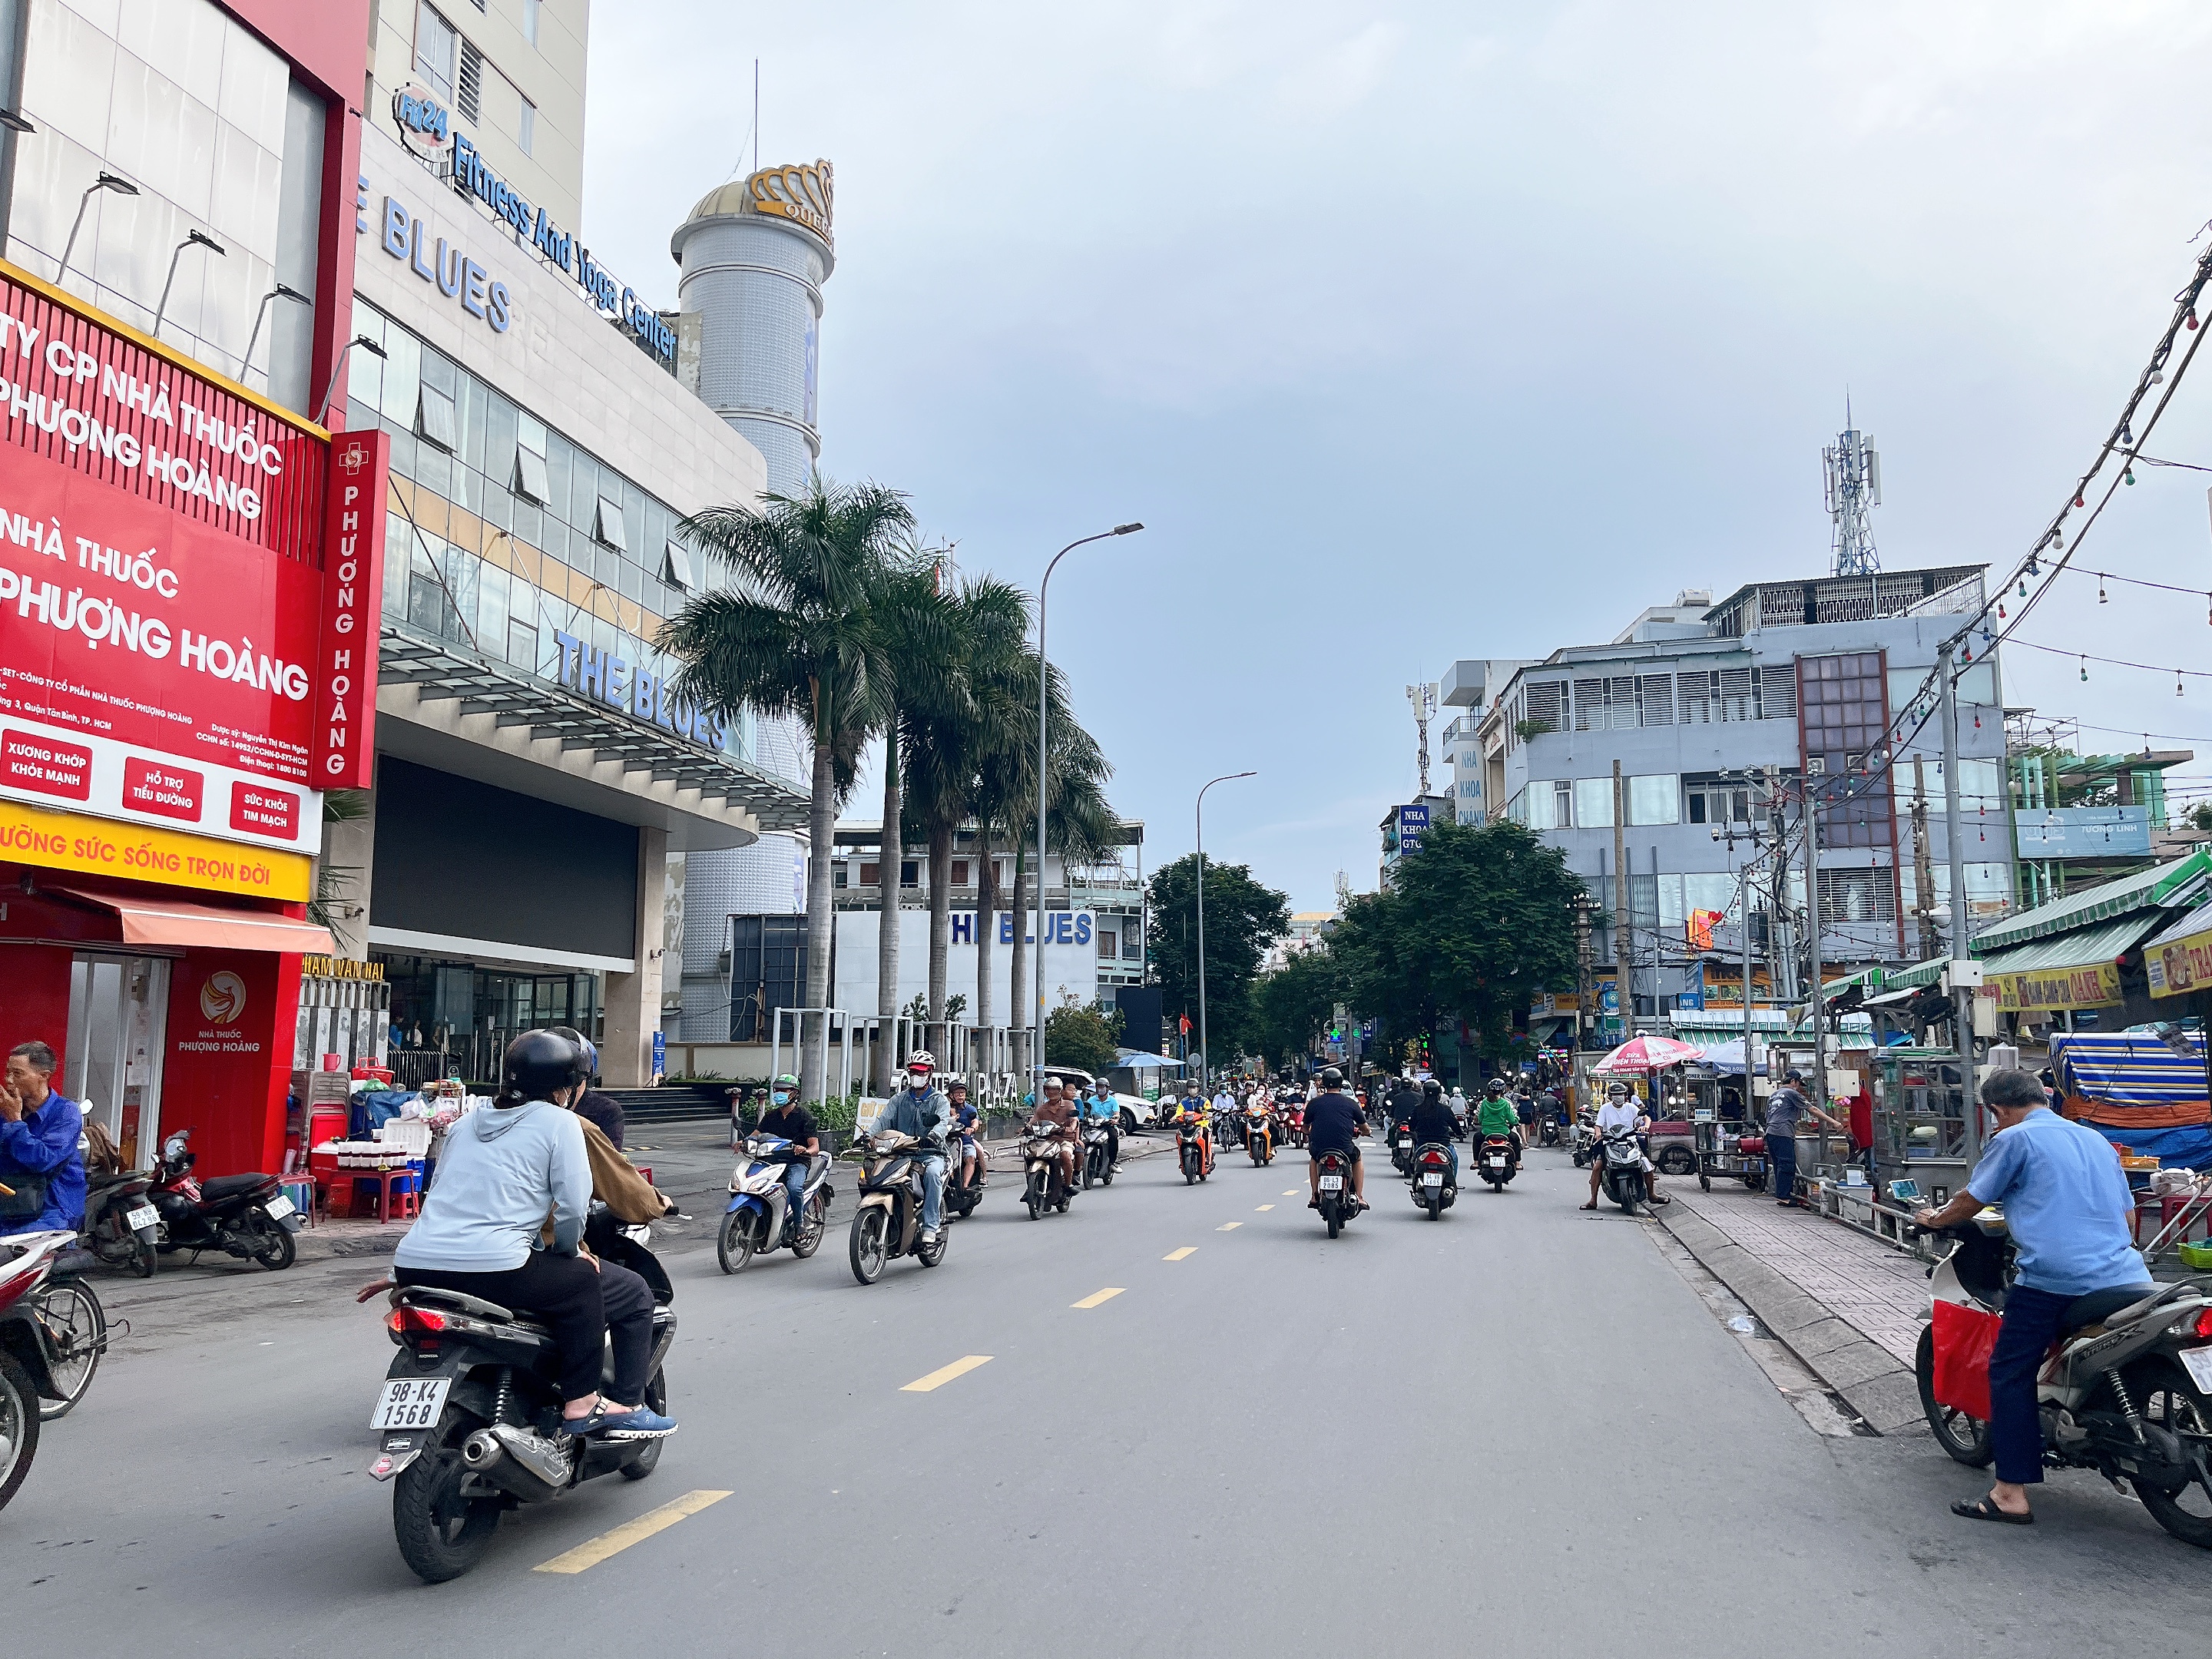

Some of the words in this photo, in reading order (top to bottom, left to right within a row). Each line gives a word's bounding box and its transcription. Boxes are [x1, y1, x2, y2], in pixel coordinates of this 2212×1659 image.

[400, 92, 448, 141] Fit24
[452, 132, 533, 235] Fitness
[534, 208, 572, 273] And
[576, 240, 617, 311] Yoga
[622, 287, 677, 359] Center
[382, 196, 511, 333] BLUES
[46, 340, 98, 384] CP
[103, 364, 174, 427] NHÀ
[180, 400, 283, 476] THUỐC
[147, 446, 261, 519] HOÀNG
[0, 508, 67, 561] NHÀ
[76, 536, 179, 598] THUỐC
[335, 487, 358, 633] PHƯỢNG
[0, 568, 172, 659] PHƯỢNG
[180, 628, 308, 700] HOÀNG
[554, 629, 626, 710] THE
[45, 679, 55, 687] TY
[92, 691, 108, 703] NHÀ
[109, 696, 134, 710] THUỐC
[136, 704, 166, 717] PHƯỢNG
[167, 711, 192, 724] HOÀNG
[326, 650, 354, 774] HOÀNG
[24, 704, 45, 715] Quận
[47, 707, 61, 718] Tân
[81, 716, 92, 727] TP.
[94, 719, 112, 730] HCM
[197, 733, 218, 744] CCHN
[242, 732, 267, 745] Nguyễn
[279, 740, 290, 750] Kim
[8, 742, 51, 761] XƯƠNG
[55, 752, 87, 769] KHỚP
[1462, 750, 1477, 768] NHA
[12, 761, 43, 778] KHỎE
[45, 770, 81, 786] MẠNH
[146, 770, 162, 784] HỖ
[164, 776, 184, 792] TRỢ
[133, 784, 154, 800] TIỂU
[156, 792, 194, 809] ĐƯỜNG
[1459, 780, 1481, 798] KHOA
[244, 793, 263, 806] SỨC
[264, 797, 288, 813] KHỎE
[1405, 811, 1425, 820] NHA
[243, 810, 259, 821] TIM
[260, 814, 287, 828] MẠCH
[73, 835, 117, 863] SỨC
[123, 843, 181, 873] SỐNG
[187, 856, 235, 882] TRỌN
[238, 864, 270, 886] ĐỜI
[365, 962, 384, 980] HAI
[198, 1029, 214, 1038] NHÀ
[217, 1028, 242, 1038] THUỐC
[179, 1041, 220, 1054] PHƯỢNG
[223, 1040, 260, 1051] HOÀNG
[978, 1072, 1018, 1109] PLAZA
[389, 1382, 439, 1402] 98-K4
[385, 1404, 432, 1426] 1568
